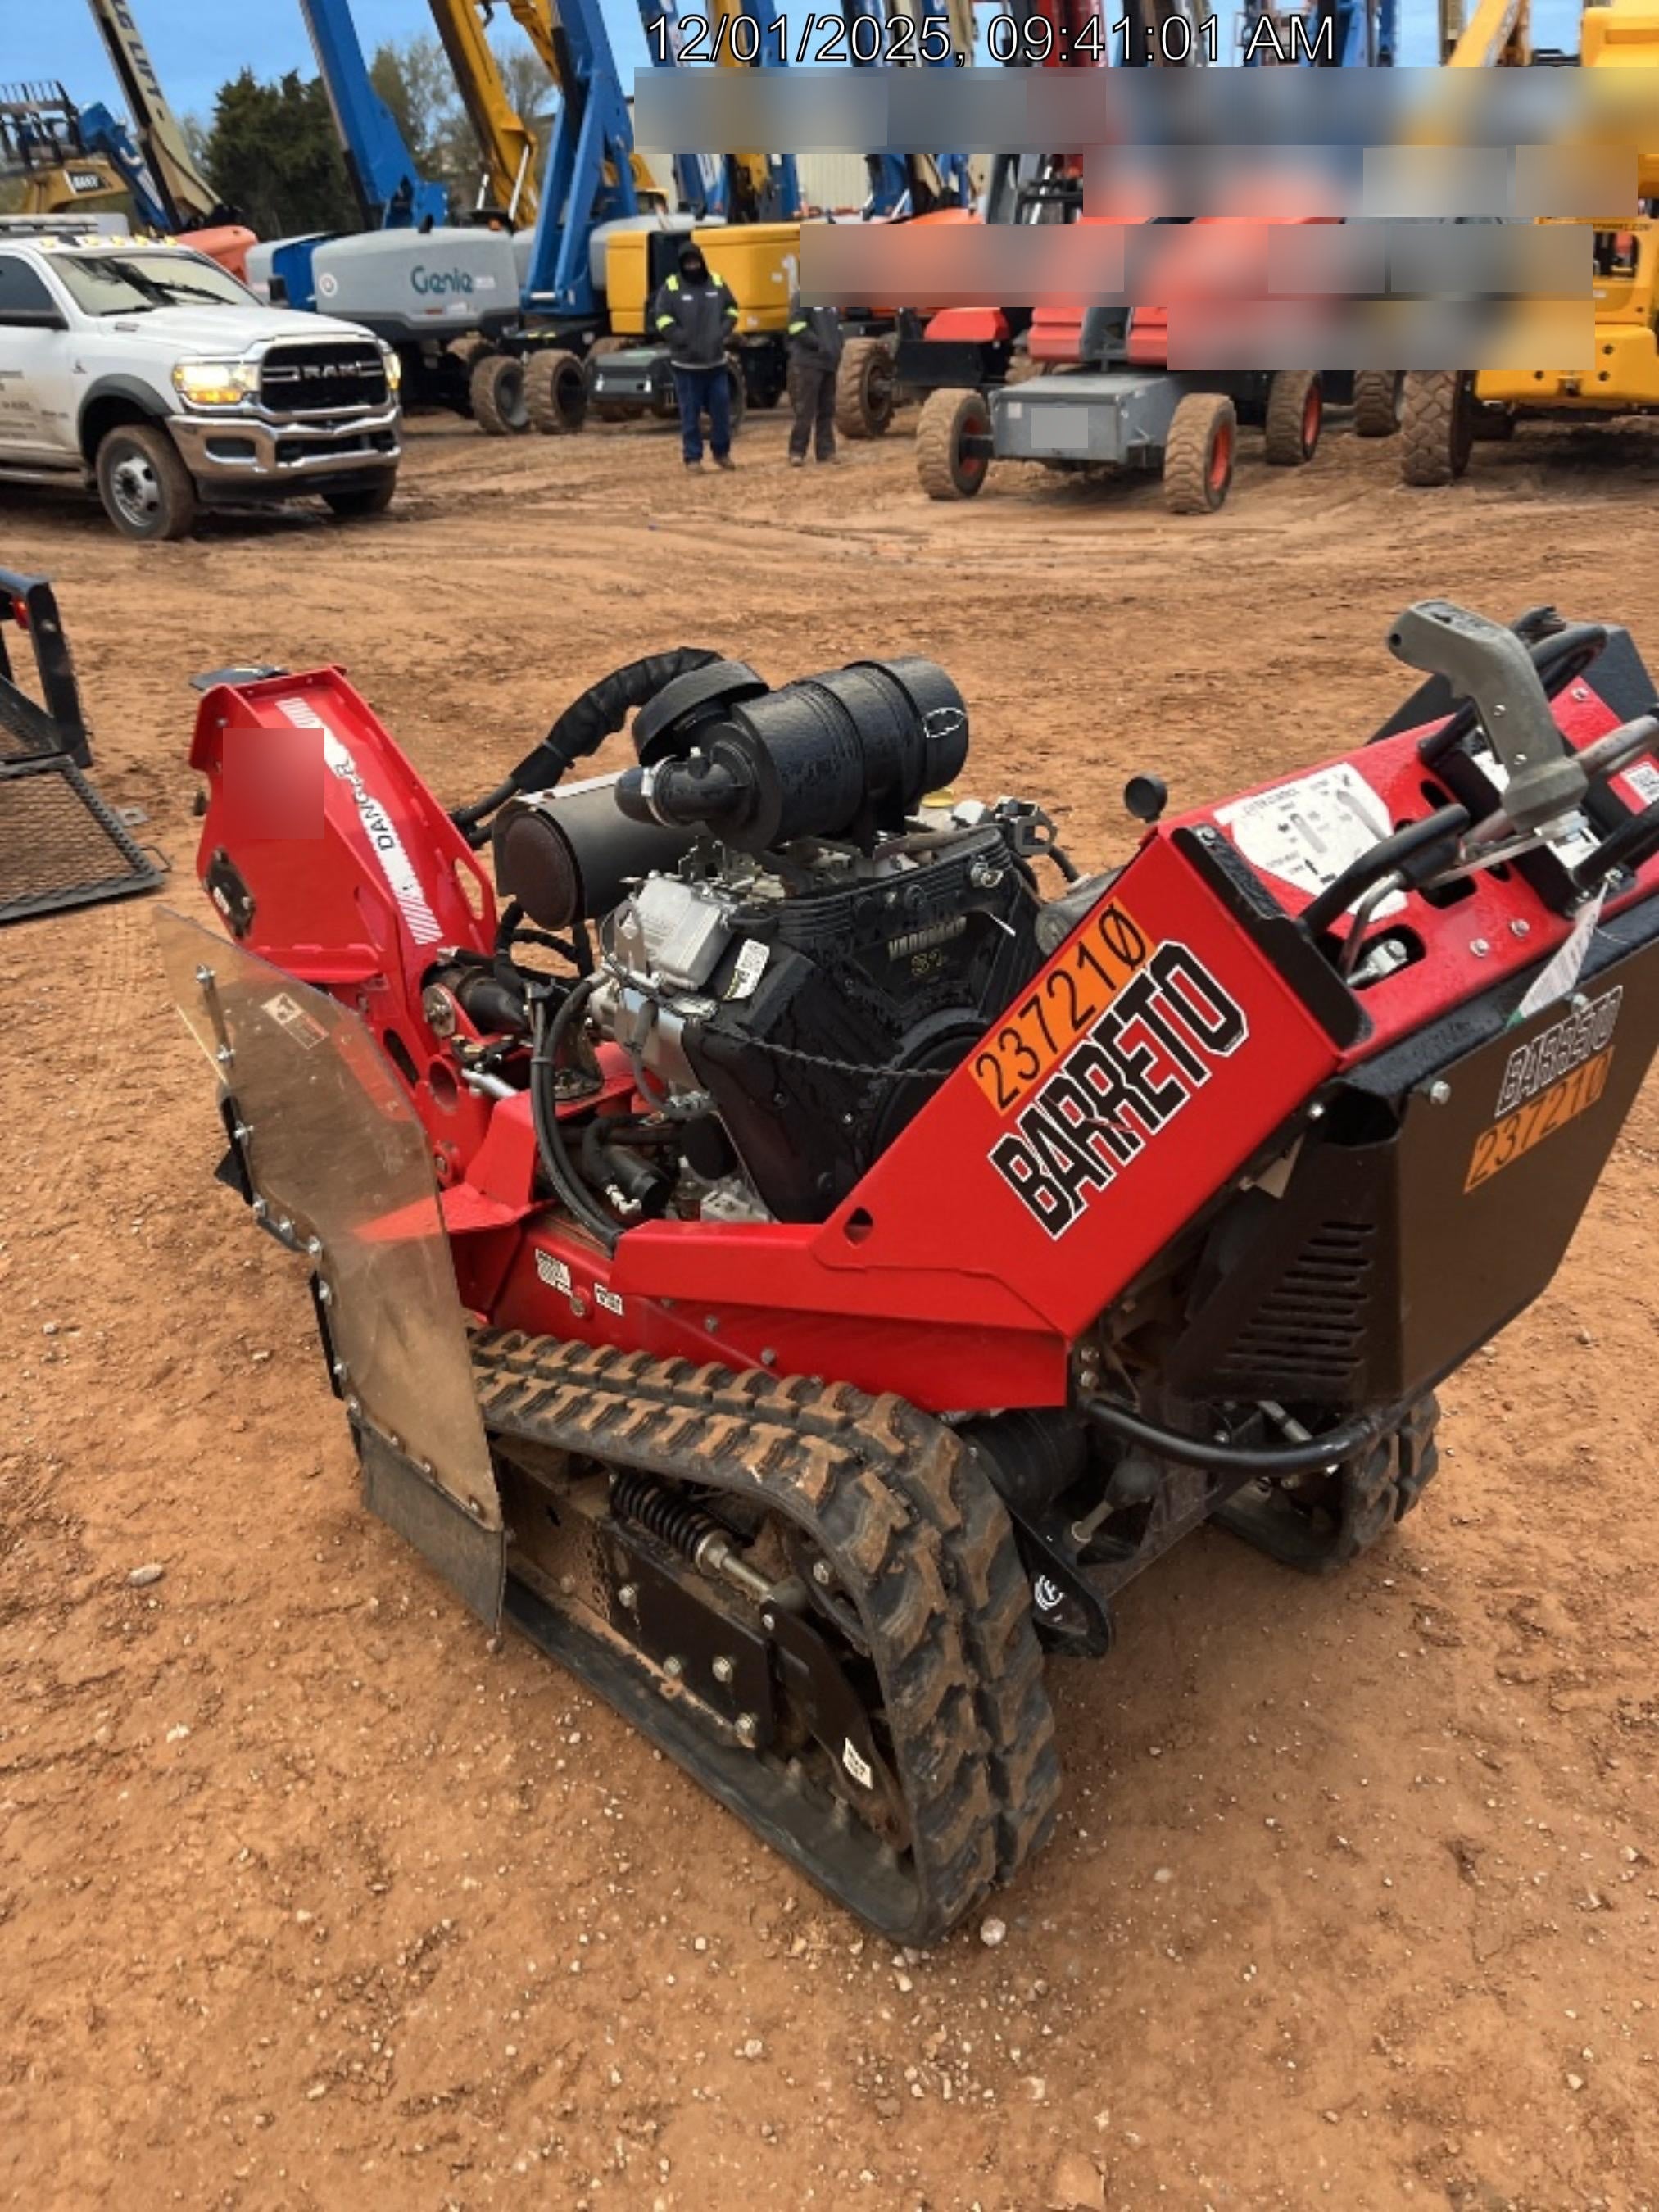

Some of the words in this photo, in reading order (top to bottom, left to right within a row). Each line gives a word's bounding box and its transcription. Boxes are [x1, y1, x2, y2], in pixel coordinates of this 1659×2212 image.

[127, 39, 164, 99] LIFT
[410, 265, 474, 295] Genie
[975, 903, 1147, 1110] 237210
[1494, 984, 1624, 1120] BARRETO
[987, 939, 1249, 1241] BARRETO
[1467, 1050, 1612, 1188] 237210
